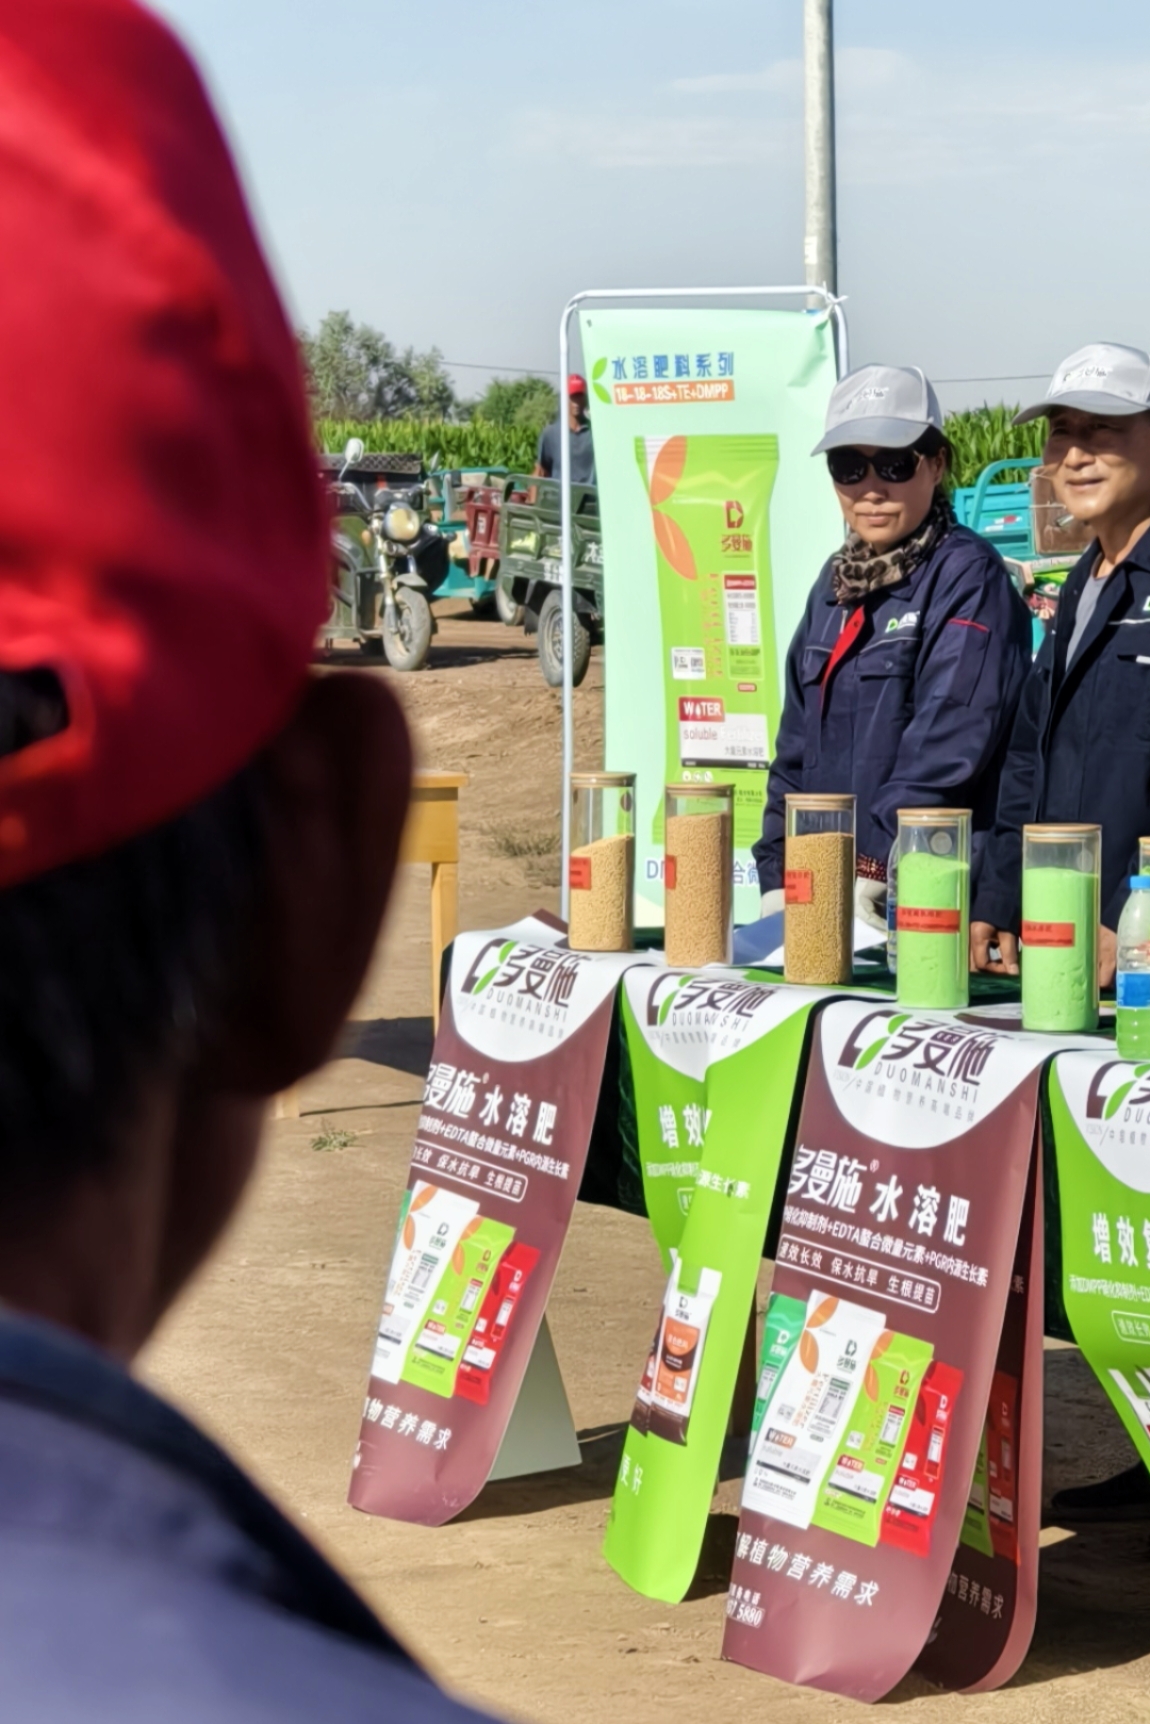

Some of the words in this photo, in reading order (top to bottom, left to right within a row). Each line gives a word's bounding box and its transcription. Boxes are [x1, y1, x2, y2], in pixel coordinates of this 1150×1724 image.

[611, 352, 735, 380] 水溶肥料系列
[486, 987, 567, 1023] DUOMANSHI
[874, 1061, 978, 1104] DUOMANSHI
[479, 1084, 557, 1146] 水溶肥
[437, 1154, 481, 1180] 保水抗旱
[869, 1174, 970, 1247] 水溶肥
[830, 1256, 879, 1285] 保水抗旱
[887, 1275, 936, 1306] 生根提苗
[363, 1396, 452, 1450] 物营养需求
[737, 1532, 879, 1606] 解植物营养需求
